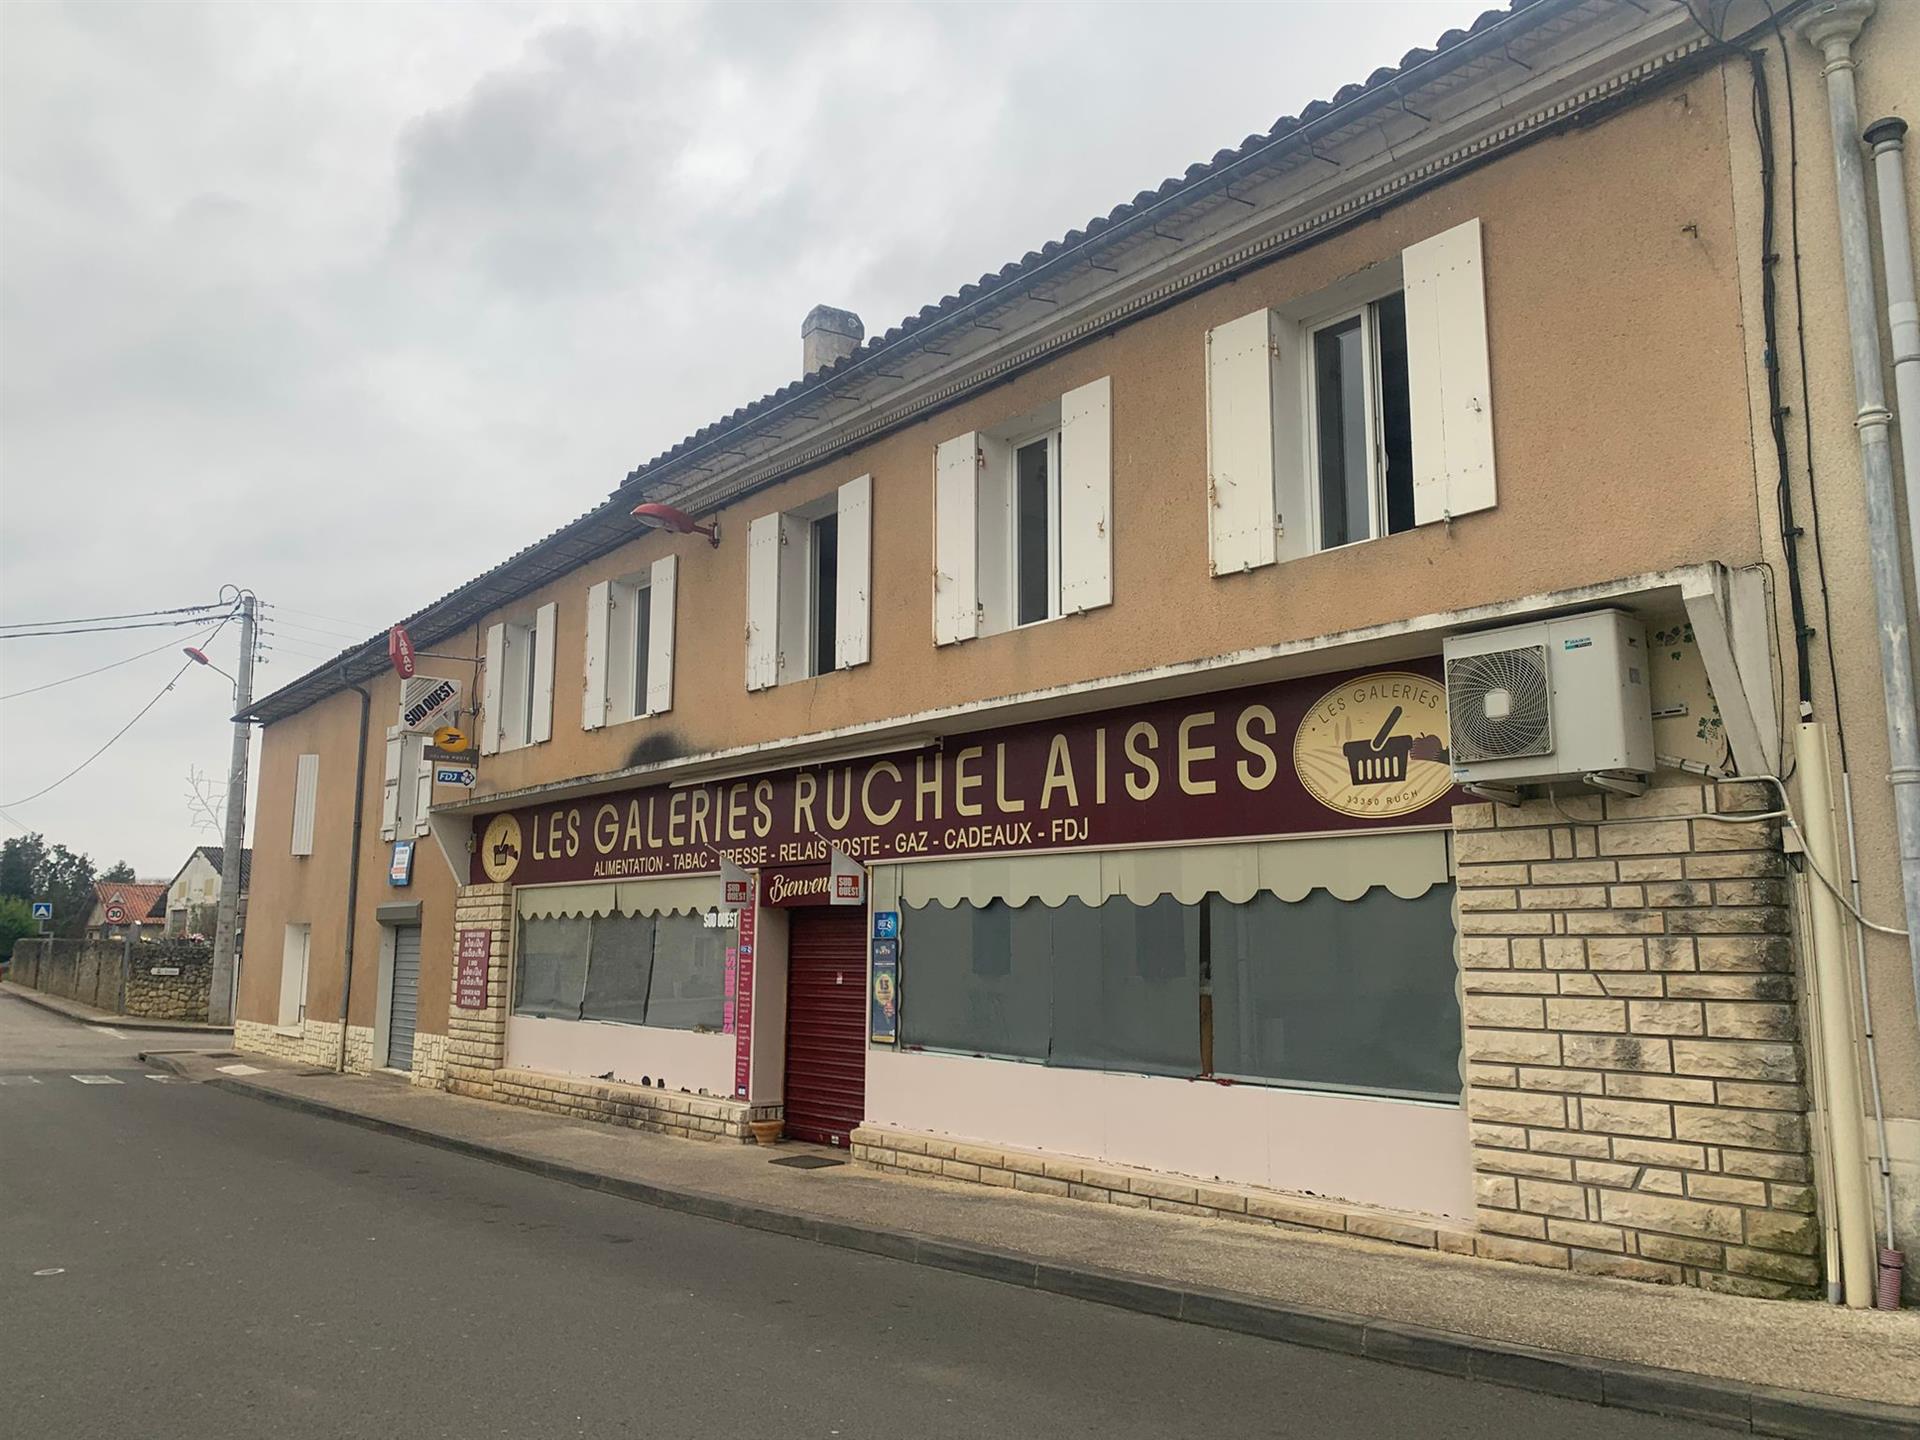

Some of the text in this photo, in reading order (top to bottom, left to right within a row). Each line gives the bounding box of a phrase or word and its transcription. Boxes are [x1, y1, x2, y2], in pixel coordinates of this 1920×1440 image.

[396, 630, 413, 673] TABAC
[404, 681, 455, 727] SUD OUEST
[1318, 683, 1439, 724] LES GALERIES
[439, 772, 457, 781] FDJ
[532, 704, 1278, 860] LES GALERIES RUCHELAISES
[1347, 790, 1418, 806] 33350 RUCH
[593, 856, 663, 877] ALIMENTATION
[673, 851, 708, 871] TABAC
[719, 845, 767, 866] PRESSE
[779, 841, 827, 862] RELAIS
[831, 836, 880, 857] POSTE
[895, 831, 928, 853] GAZ
[944, 822, 1032, 848] CADEAUX
[1051, 817, 1089, 842] FDJ
[727, 883, 740, 893] SUD
[838, 877, 853, 887] SUD
[727, 892, 746, 901] OUEST
[838, 886, 859, 896] OUEST
[110, 910, 121, 918] 30
[703, 913, 717, 929] SUD
[717, 911, 738, 928] OUEST
[723, 1001, 735, 1034] SUD
